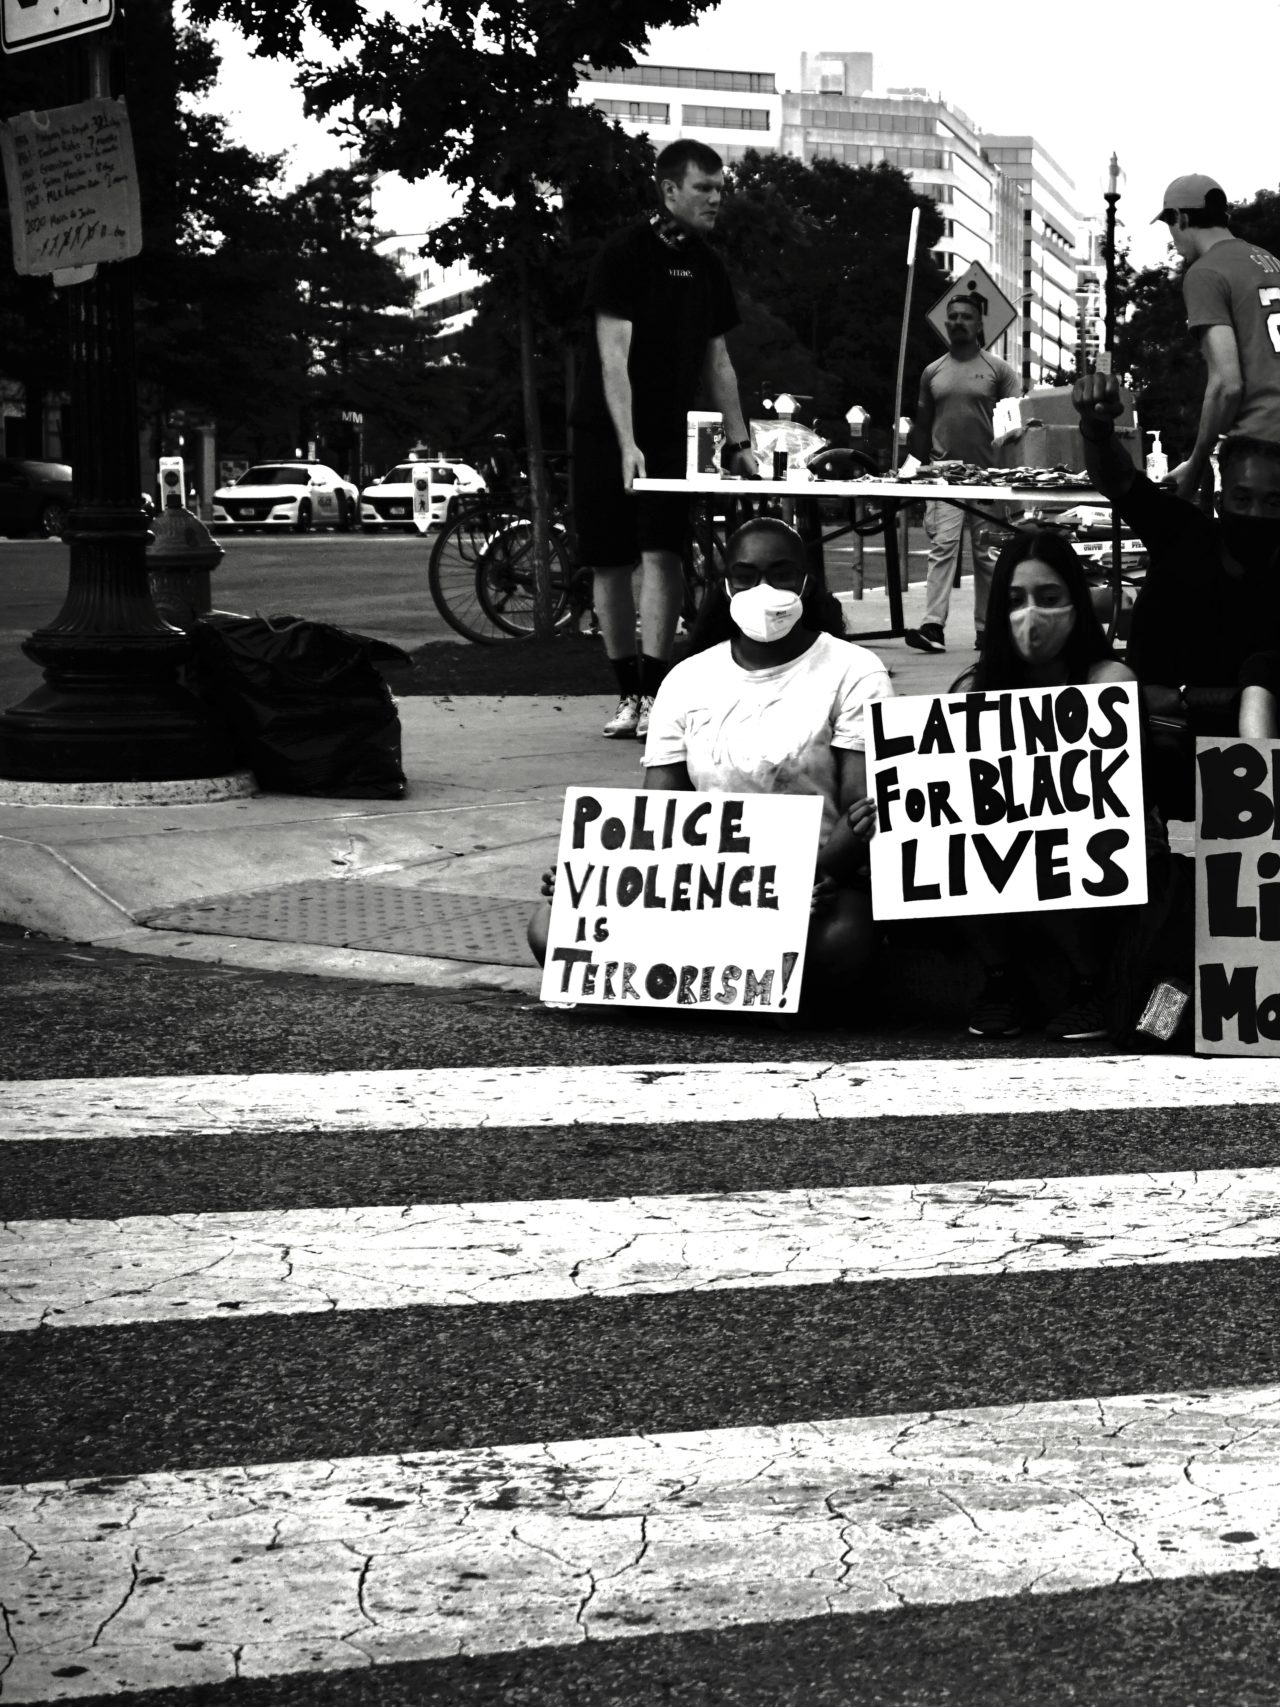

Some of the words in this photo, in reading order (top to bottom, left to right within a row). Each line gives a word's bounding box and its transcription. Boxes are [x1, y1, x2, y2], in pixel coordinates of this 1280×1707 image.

[871, 686, 1130, 761] LATINOS
[875, 766, 963, 833] FOR
[969, 749, 1131, 826] BLACK
[572, 796, 750, 854] POLICE
[563, 861, 780, 912] VIOLENCE
[901, 828, 1130, 902] LIVES
[575, 916, 610, 943] IS
[551, 947, 800, 1009] TERRORISM!
